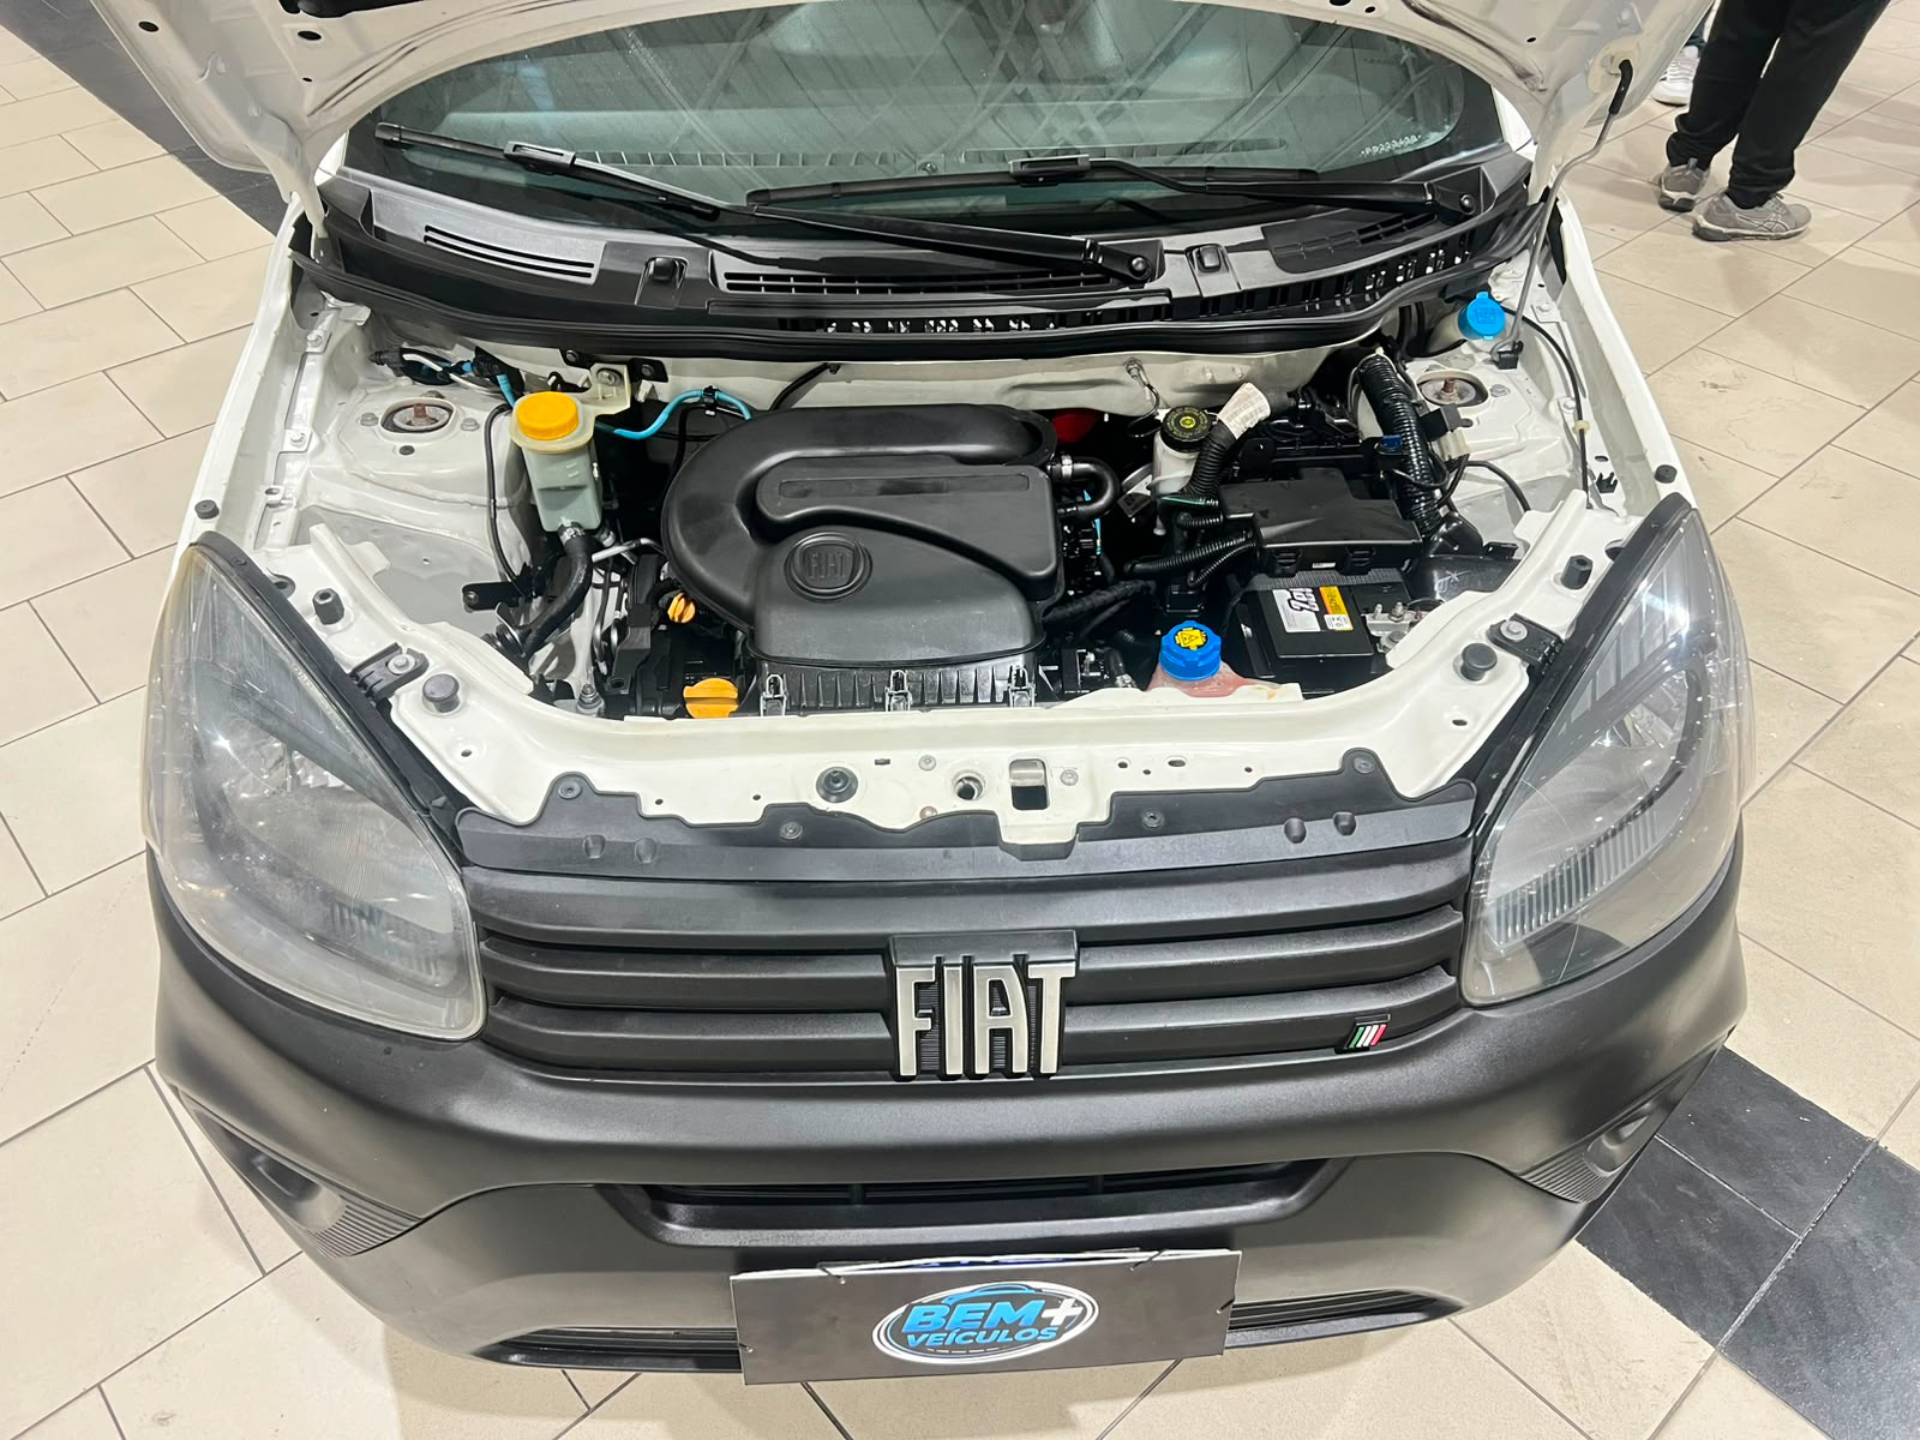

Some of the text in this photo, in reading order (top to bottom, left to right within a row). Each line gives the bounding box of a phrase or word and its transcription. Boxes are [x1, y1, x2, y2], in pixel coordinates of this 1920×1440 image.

[807, 551, 852, 578] FIAT
[896, 962, 1076, 1076] FIAT
[907, 1327, 1058, 1348] VEÍCULOS
